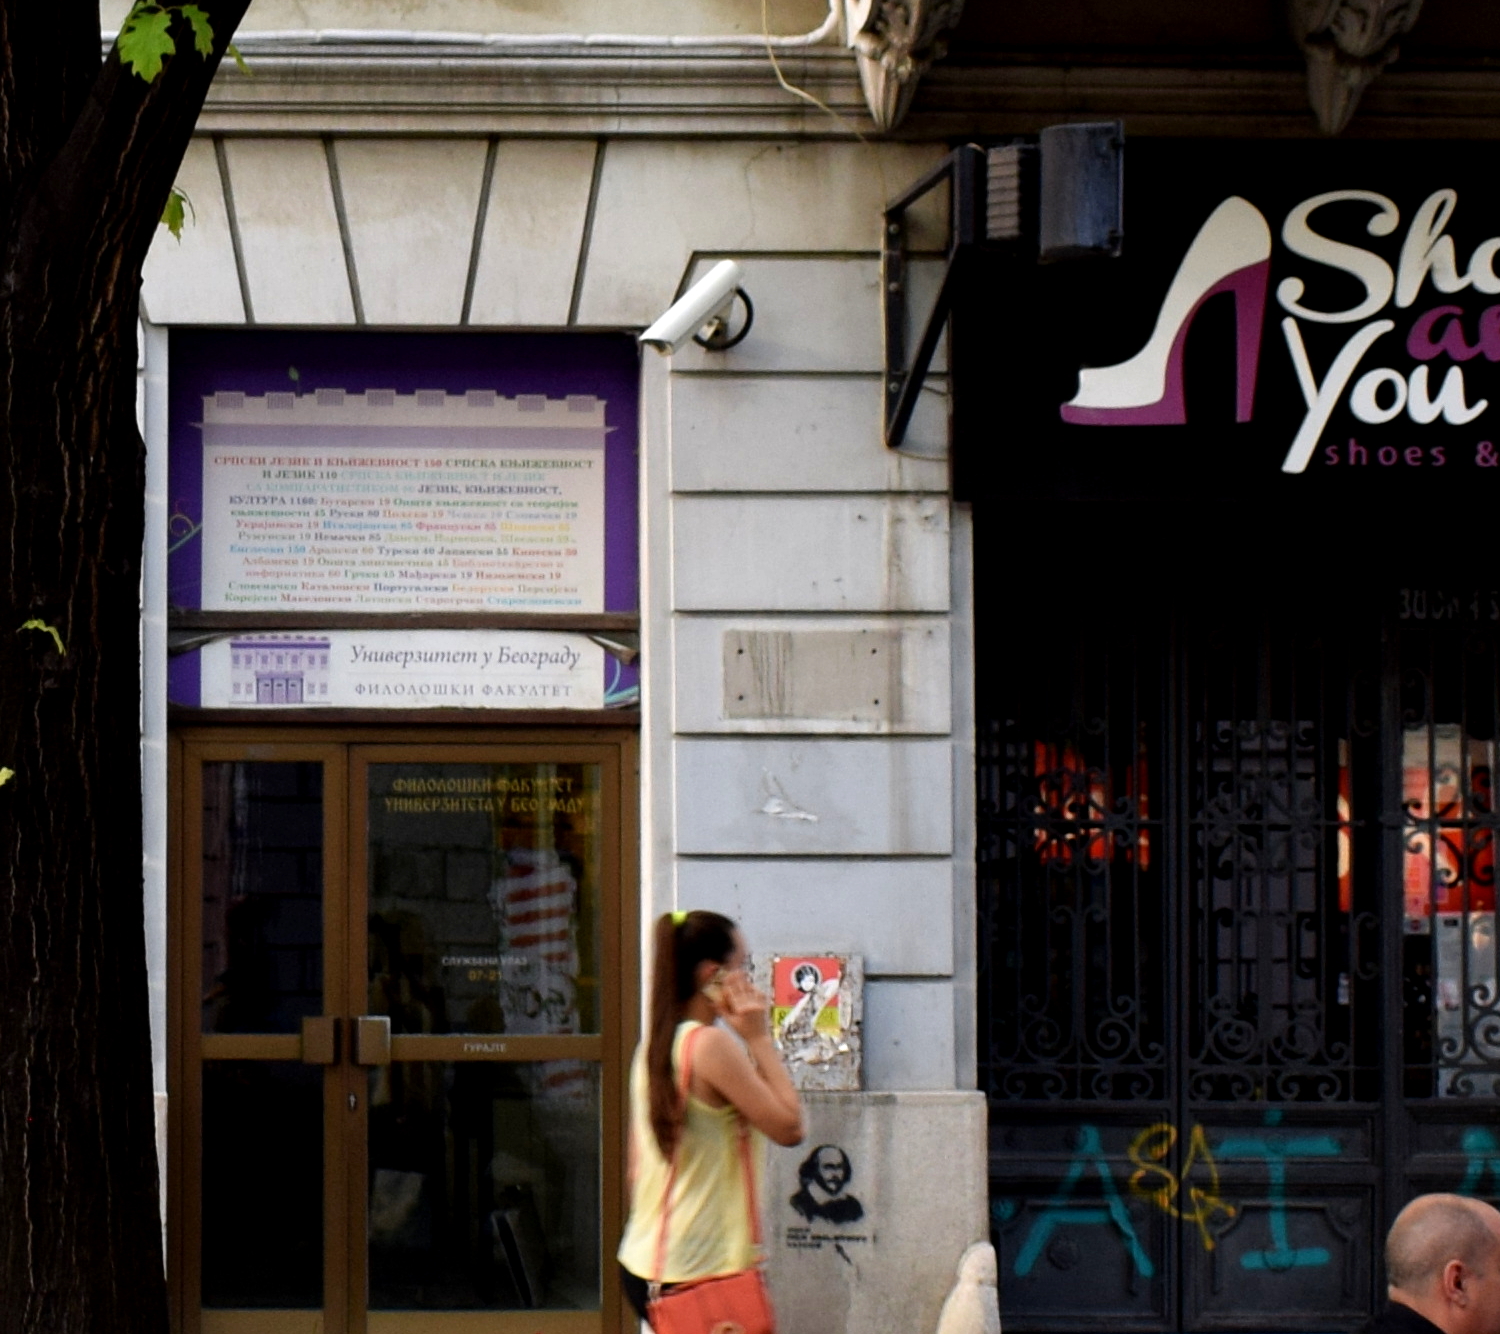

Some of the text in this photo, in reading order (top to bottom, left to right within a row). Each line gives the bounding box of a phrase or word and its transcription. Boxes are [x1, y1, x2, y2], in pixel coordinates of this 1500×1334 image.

[1281, 317, 1488, 473] You
[1325, 440, 1447, 468] shoes
[1475, 442, 1499, 467] &
[350, 644, 581, 670] Универзитет у Београду
[355, 683, 572, 697] ФИЛОЛОШКИ ФАКУЛТЕТ
[393, 778, 491, 792] ФИЛОЛОШКИ
